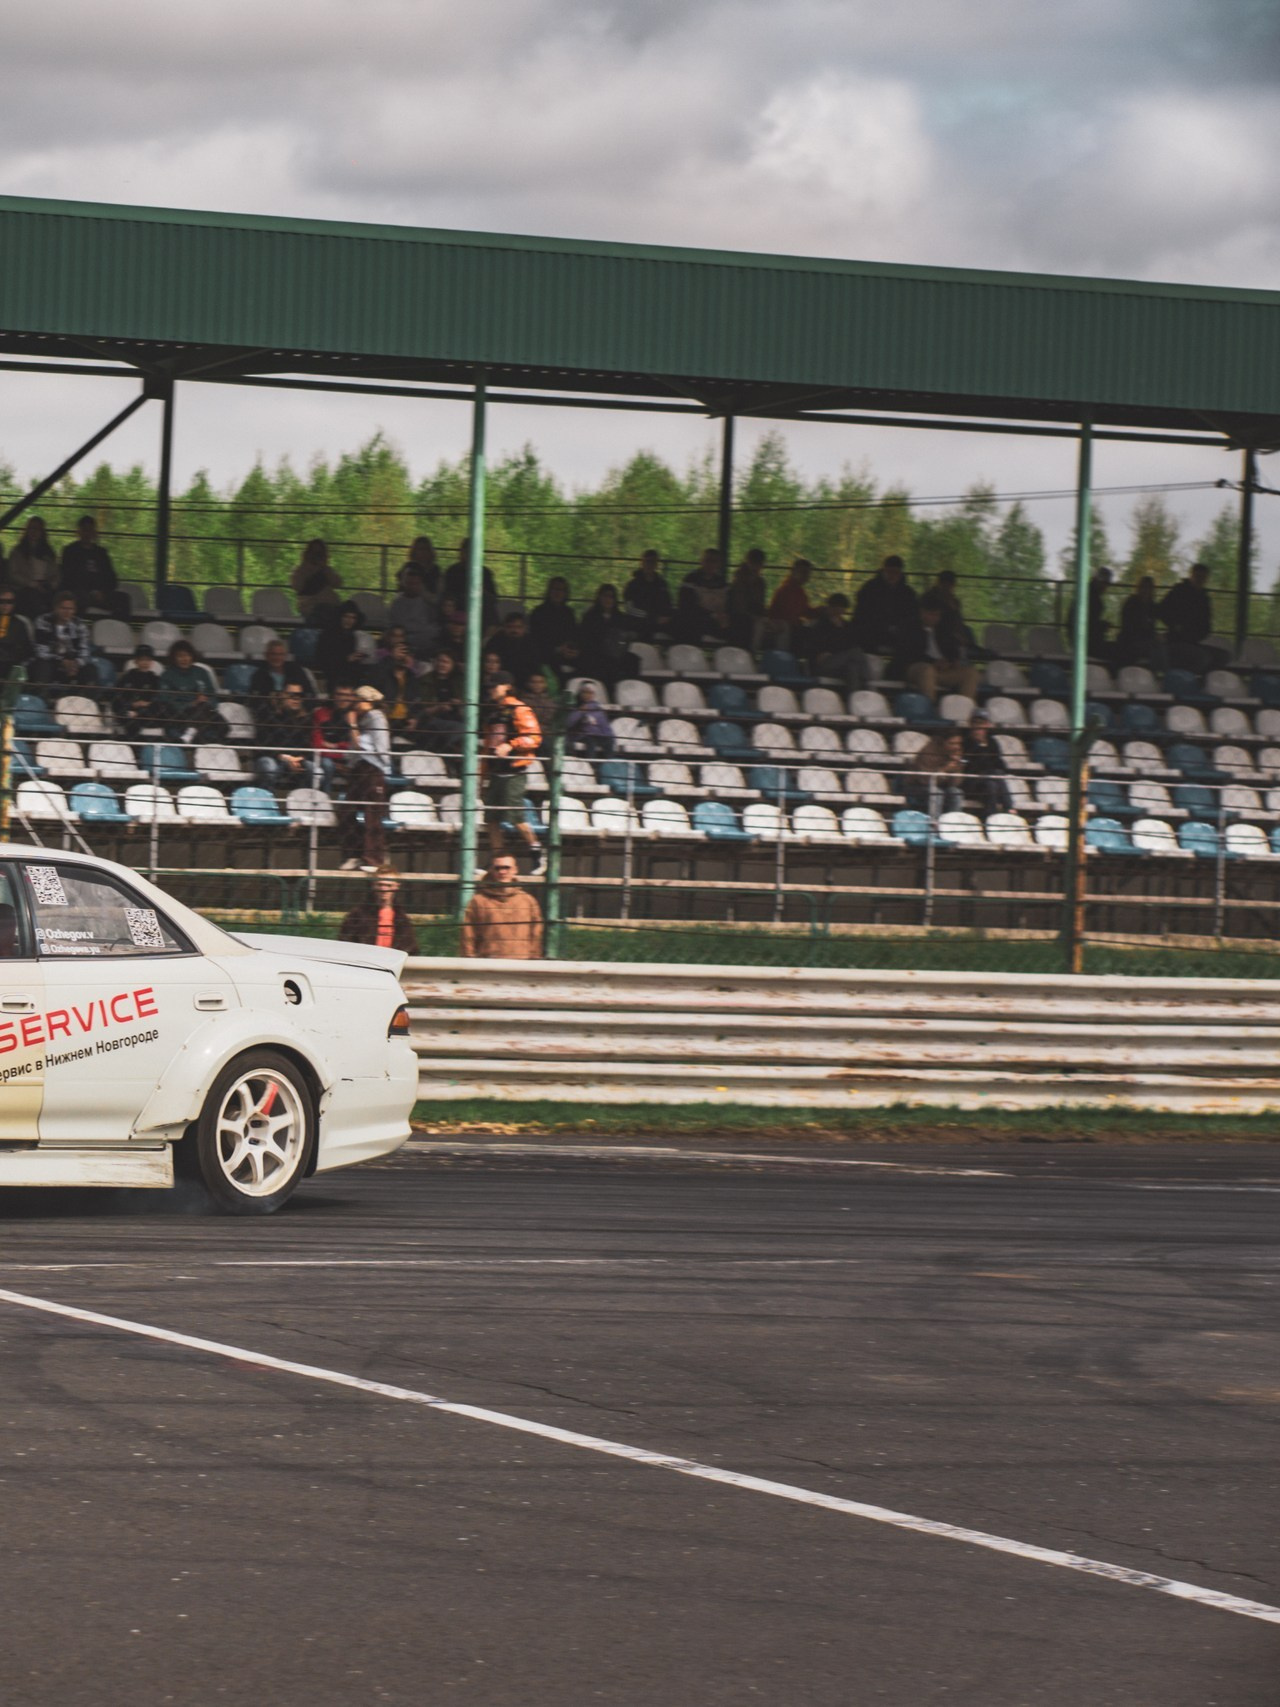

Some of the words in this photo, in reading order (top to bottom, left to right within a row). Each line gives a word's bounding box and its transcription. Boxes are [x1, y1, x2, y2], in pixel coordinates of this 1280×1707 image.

[35, 1060, 44, 1072] в
[45, 1044, 93, 1069] Нижнем
[95, 1028, 160, 1054] Новгороде
